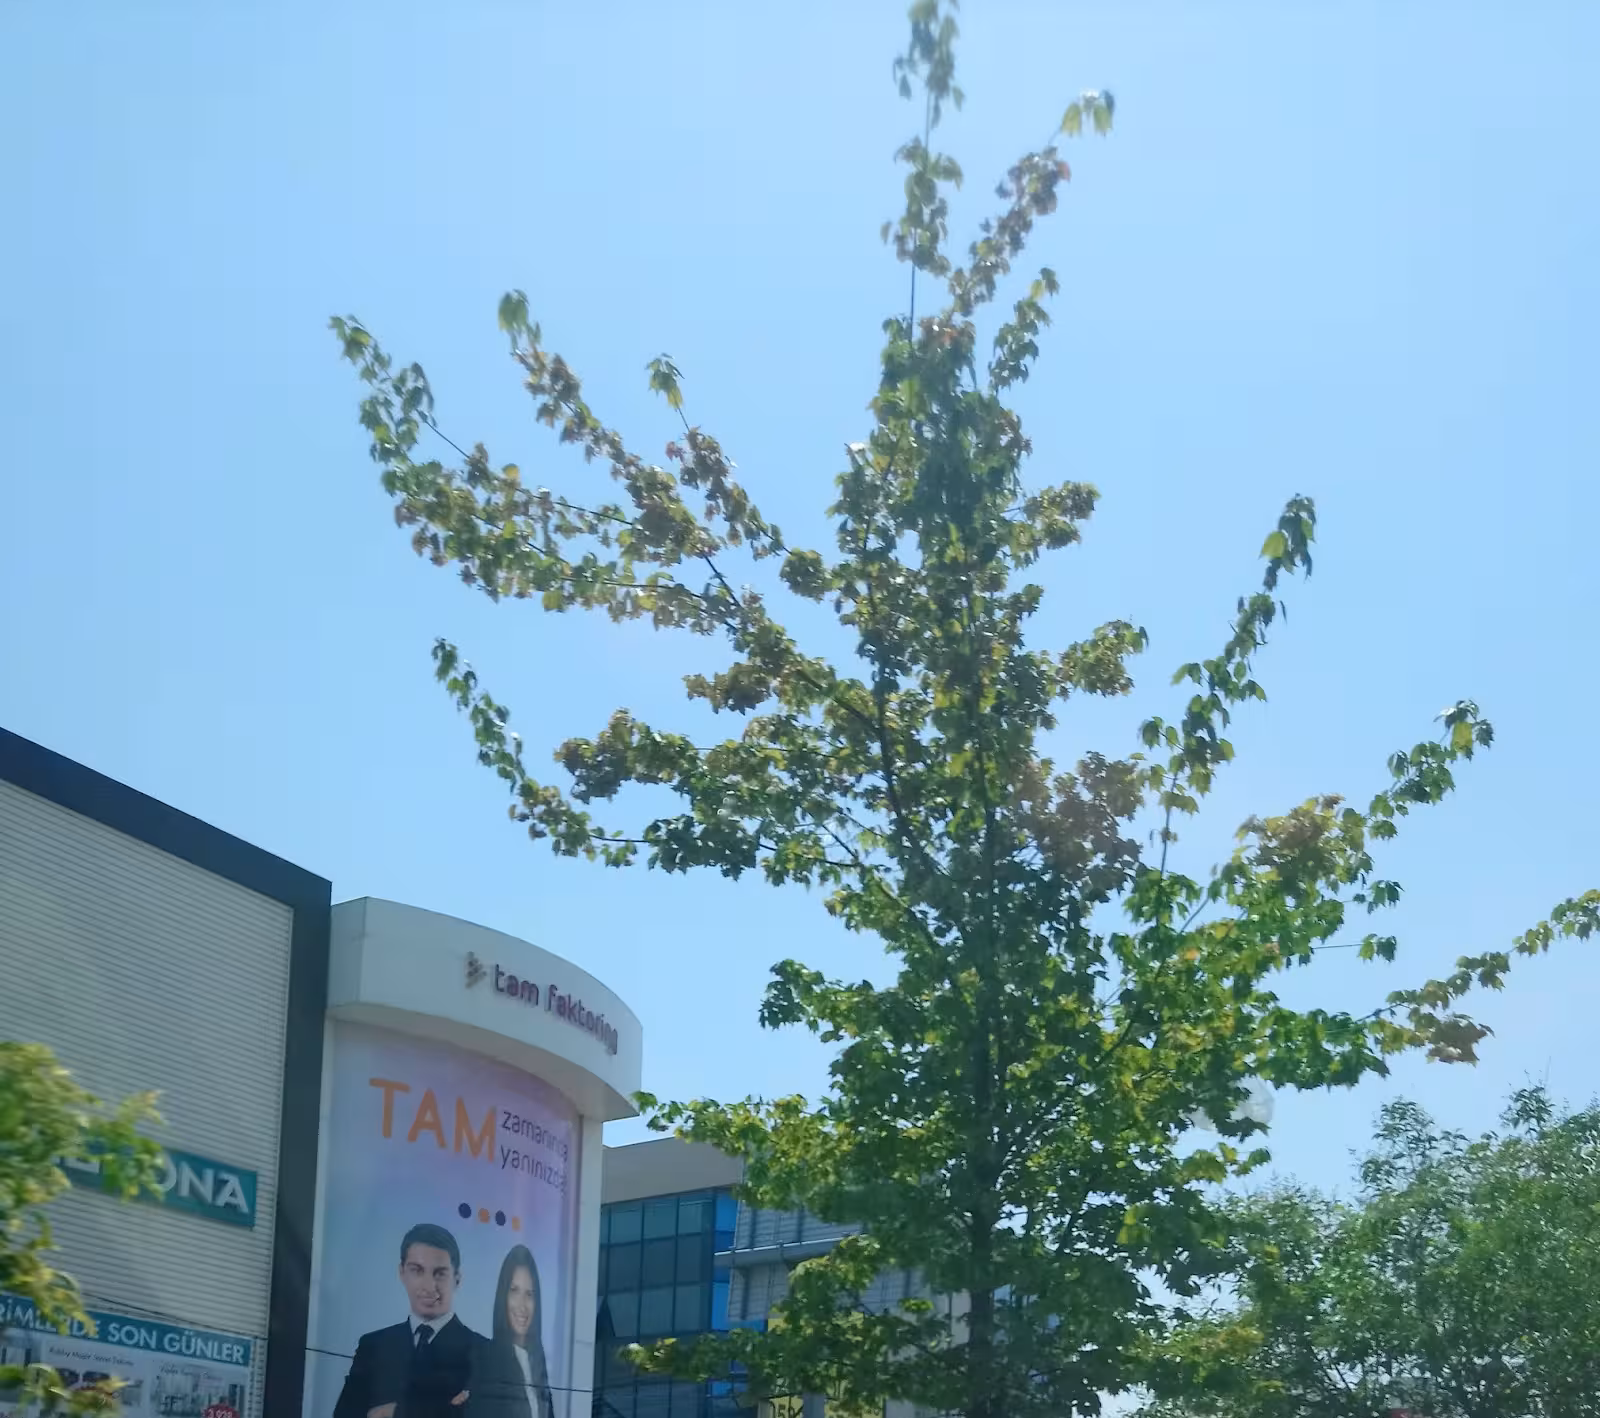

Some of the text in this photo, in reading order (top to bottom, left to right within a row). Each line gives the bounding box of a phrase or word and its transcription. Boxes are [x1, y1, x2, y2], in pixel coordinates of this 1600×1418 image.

[494, 963, 619, 1056] tam faktoring
[369, 1077, 498, 1164] TAM
[107, 1321, 158, 1349] SON
[163, 1329, 246, 1365] GÜNLER
